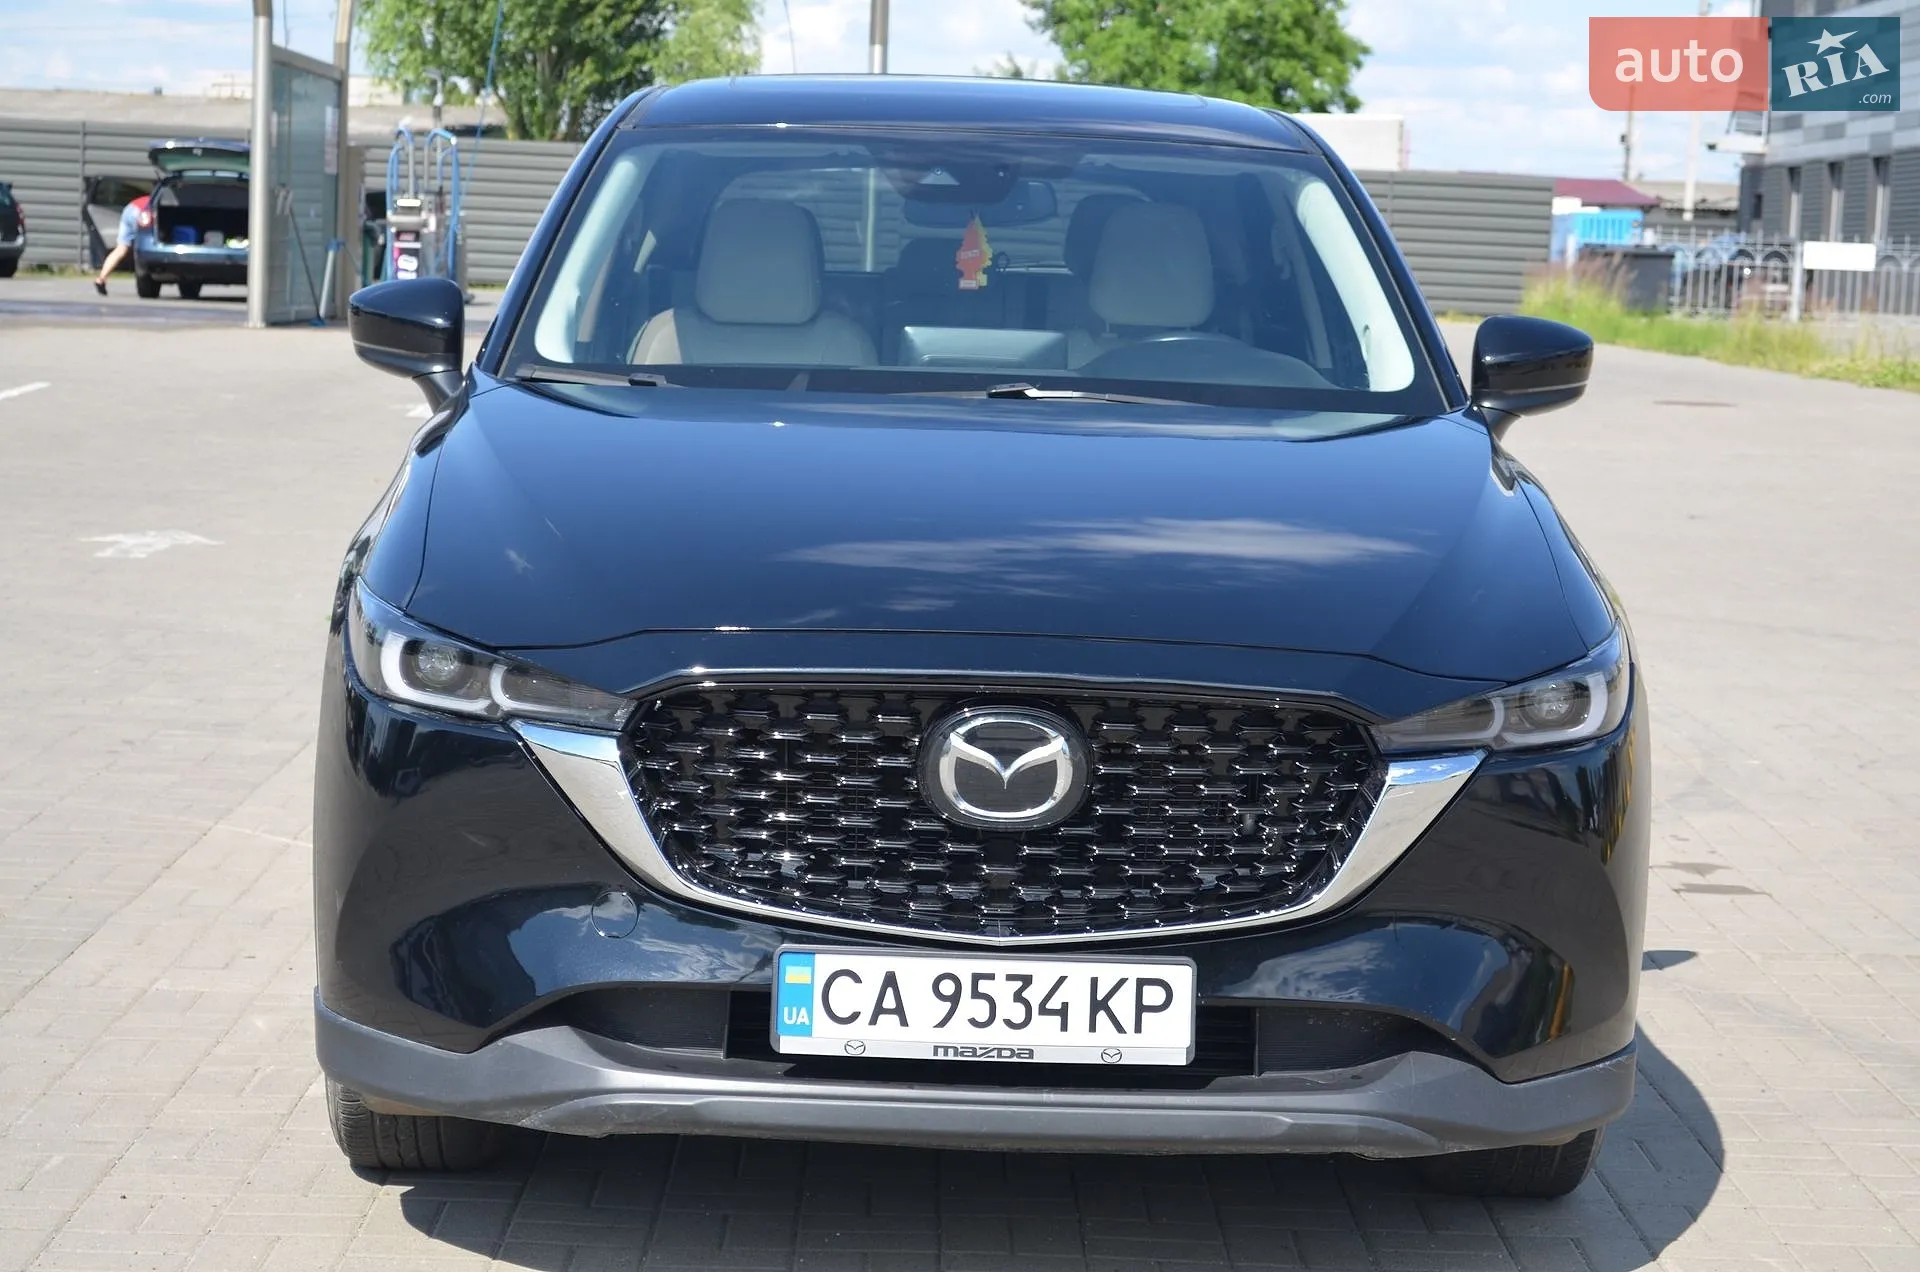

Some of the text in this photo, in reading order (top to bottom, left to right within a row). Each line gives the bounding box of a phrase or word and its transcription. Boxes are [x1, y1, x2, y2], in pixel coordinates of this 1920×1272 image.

[783, 1007, 811, 1026] UA
[821, 968, 1174, 1035] CA 9534 KP
